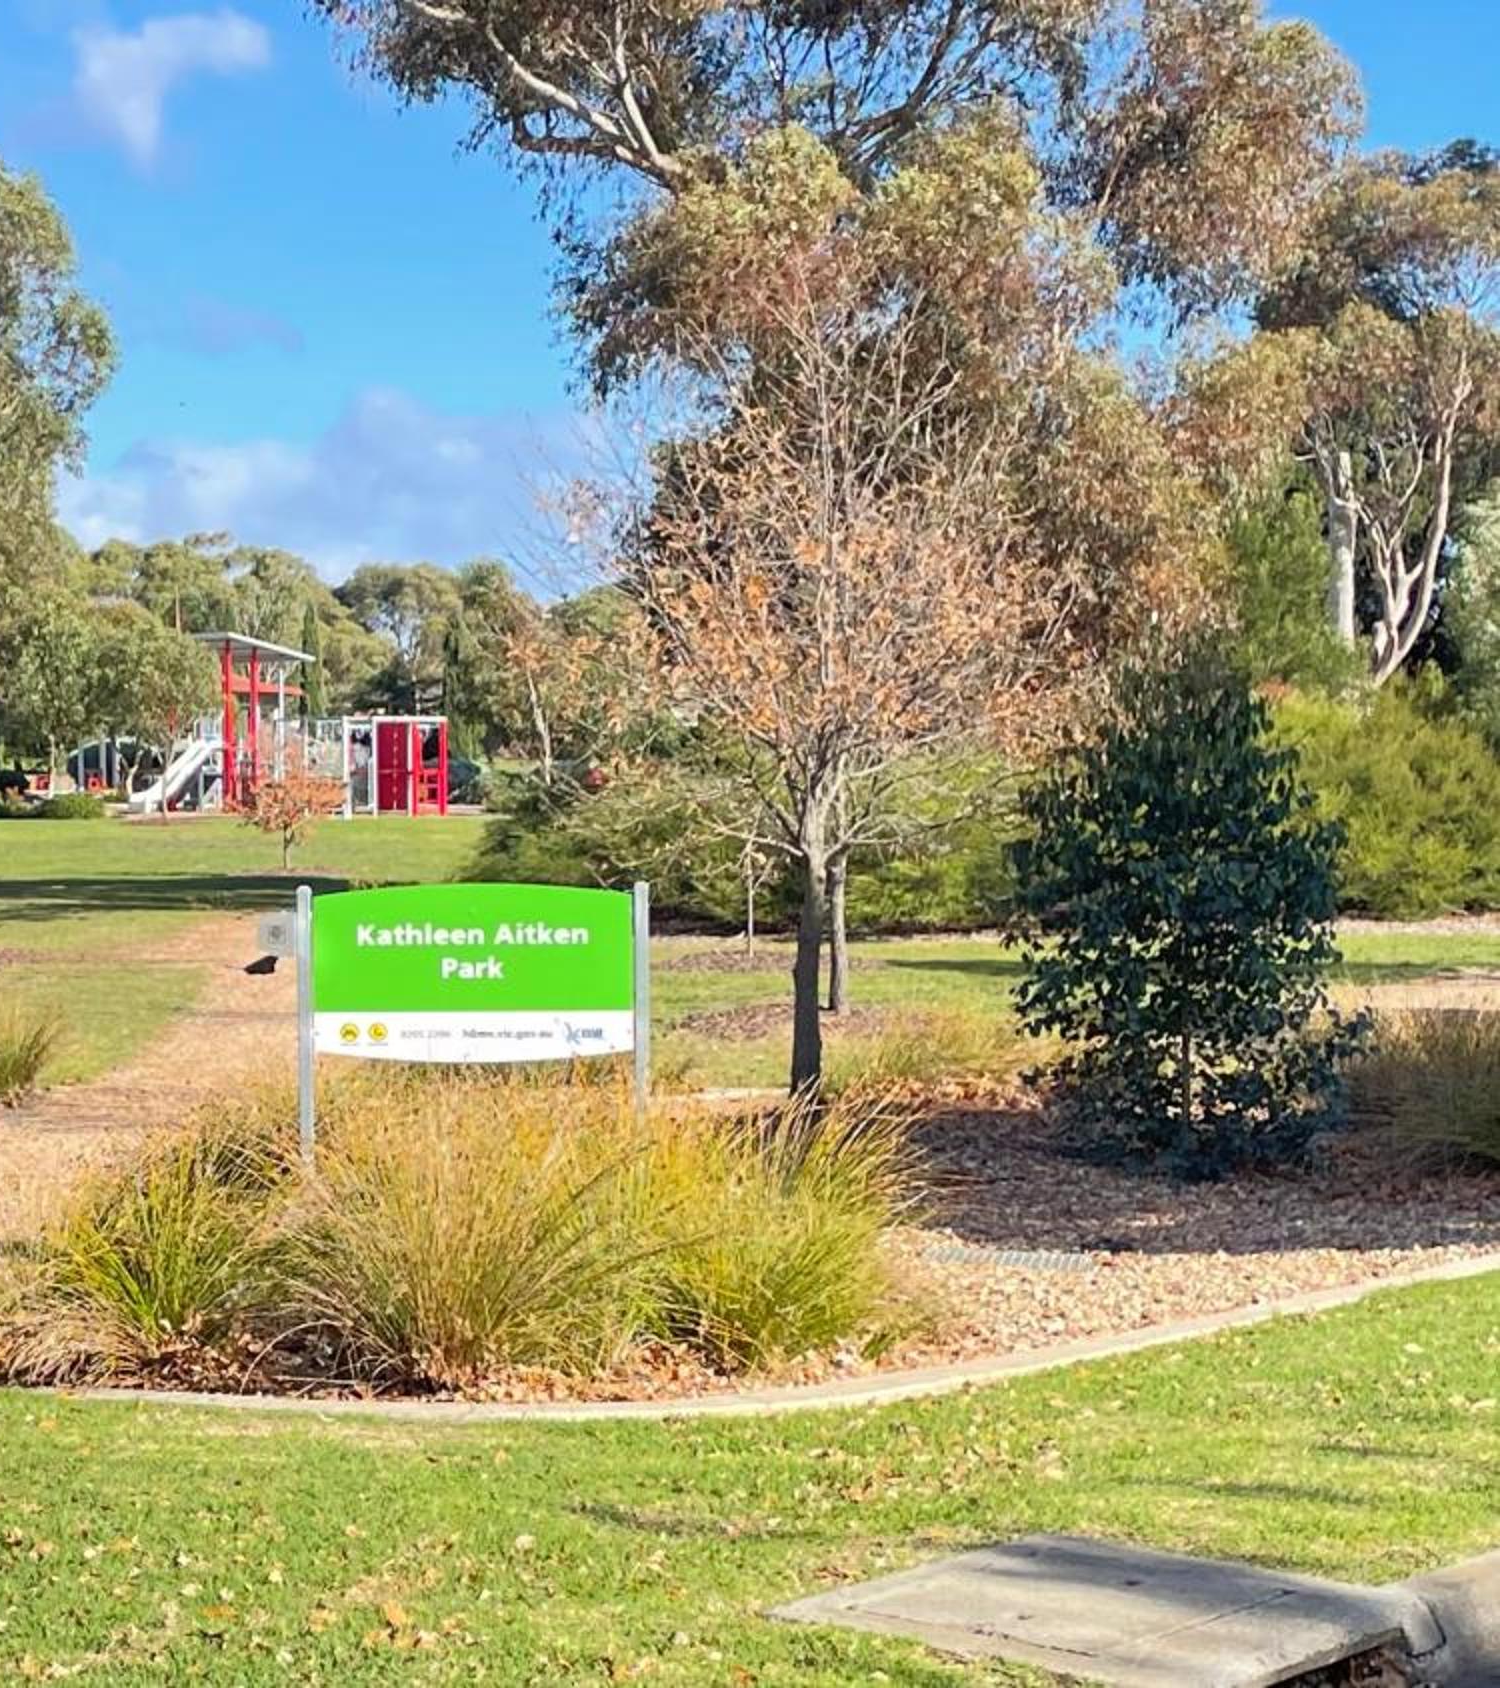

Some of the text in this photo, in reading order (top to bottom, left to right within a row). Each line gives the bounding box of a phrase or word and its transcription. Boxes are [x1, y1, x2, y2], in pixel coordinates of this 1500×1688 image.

[357, 921, 589, 946] Kathleen Aitken
[441, 956, 504, 979] Park
